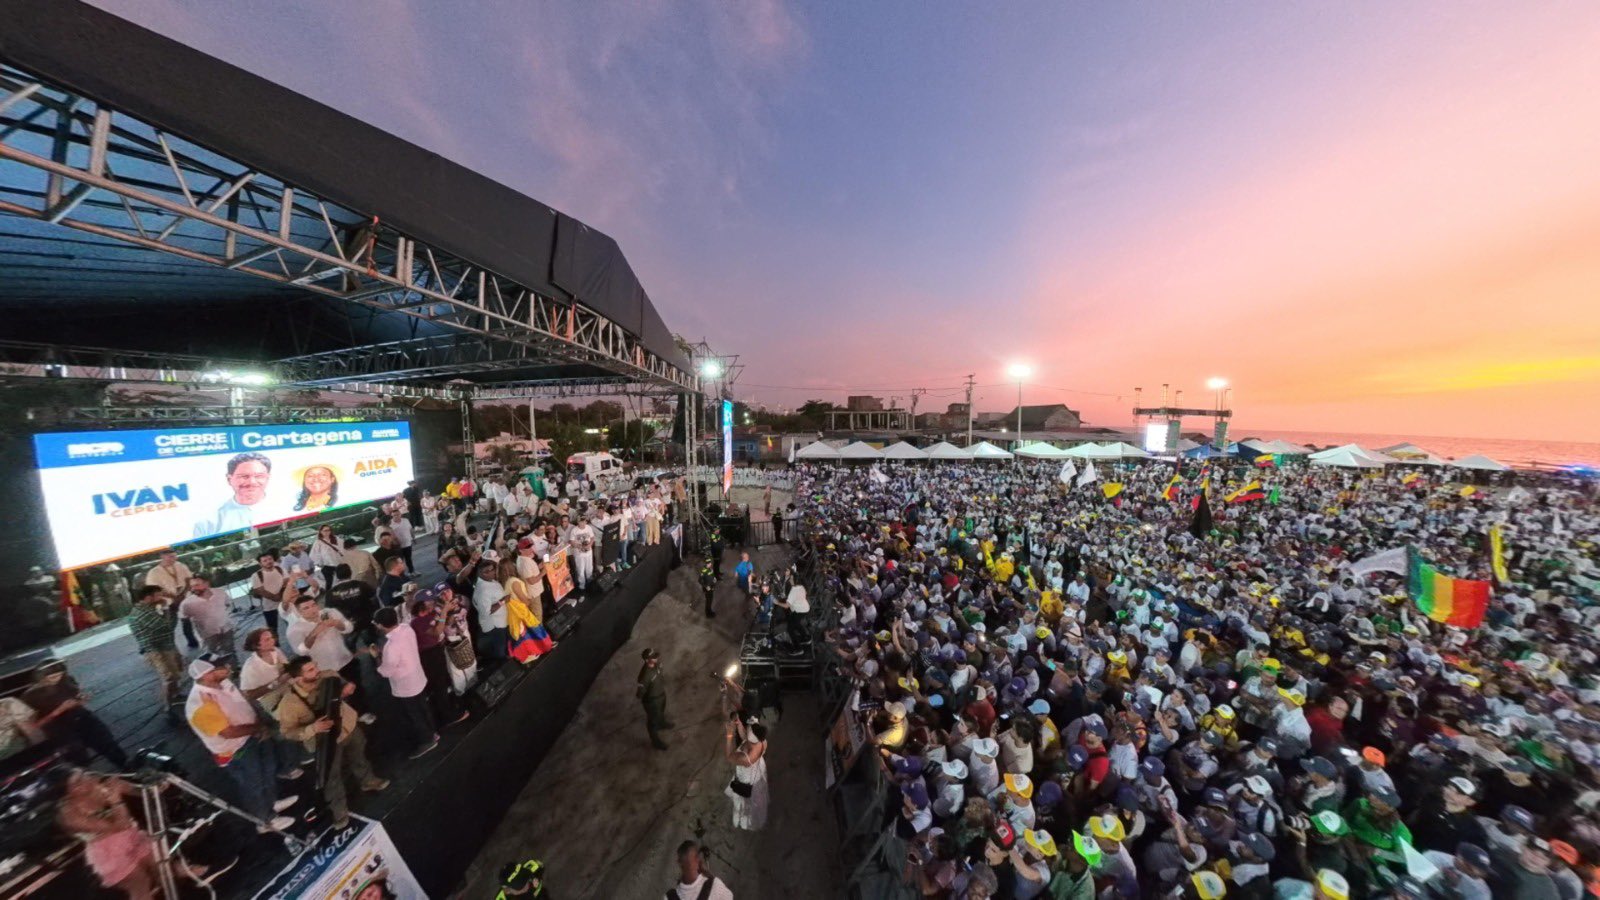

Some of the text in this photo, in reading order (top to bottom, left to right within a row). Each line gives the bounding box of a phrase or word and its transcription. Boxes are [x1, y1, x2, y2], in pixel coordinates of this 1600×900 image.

[154, 432, 228, 447] CIERRE
[242, 430, 362, 448] Cartagena
[354, 457, 398, 475] AIDA
[110, 502, 178, 518] CEPEDA
[313, 826, 359, 866] Vota
